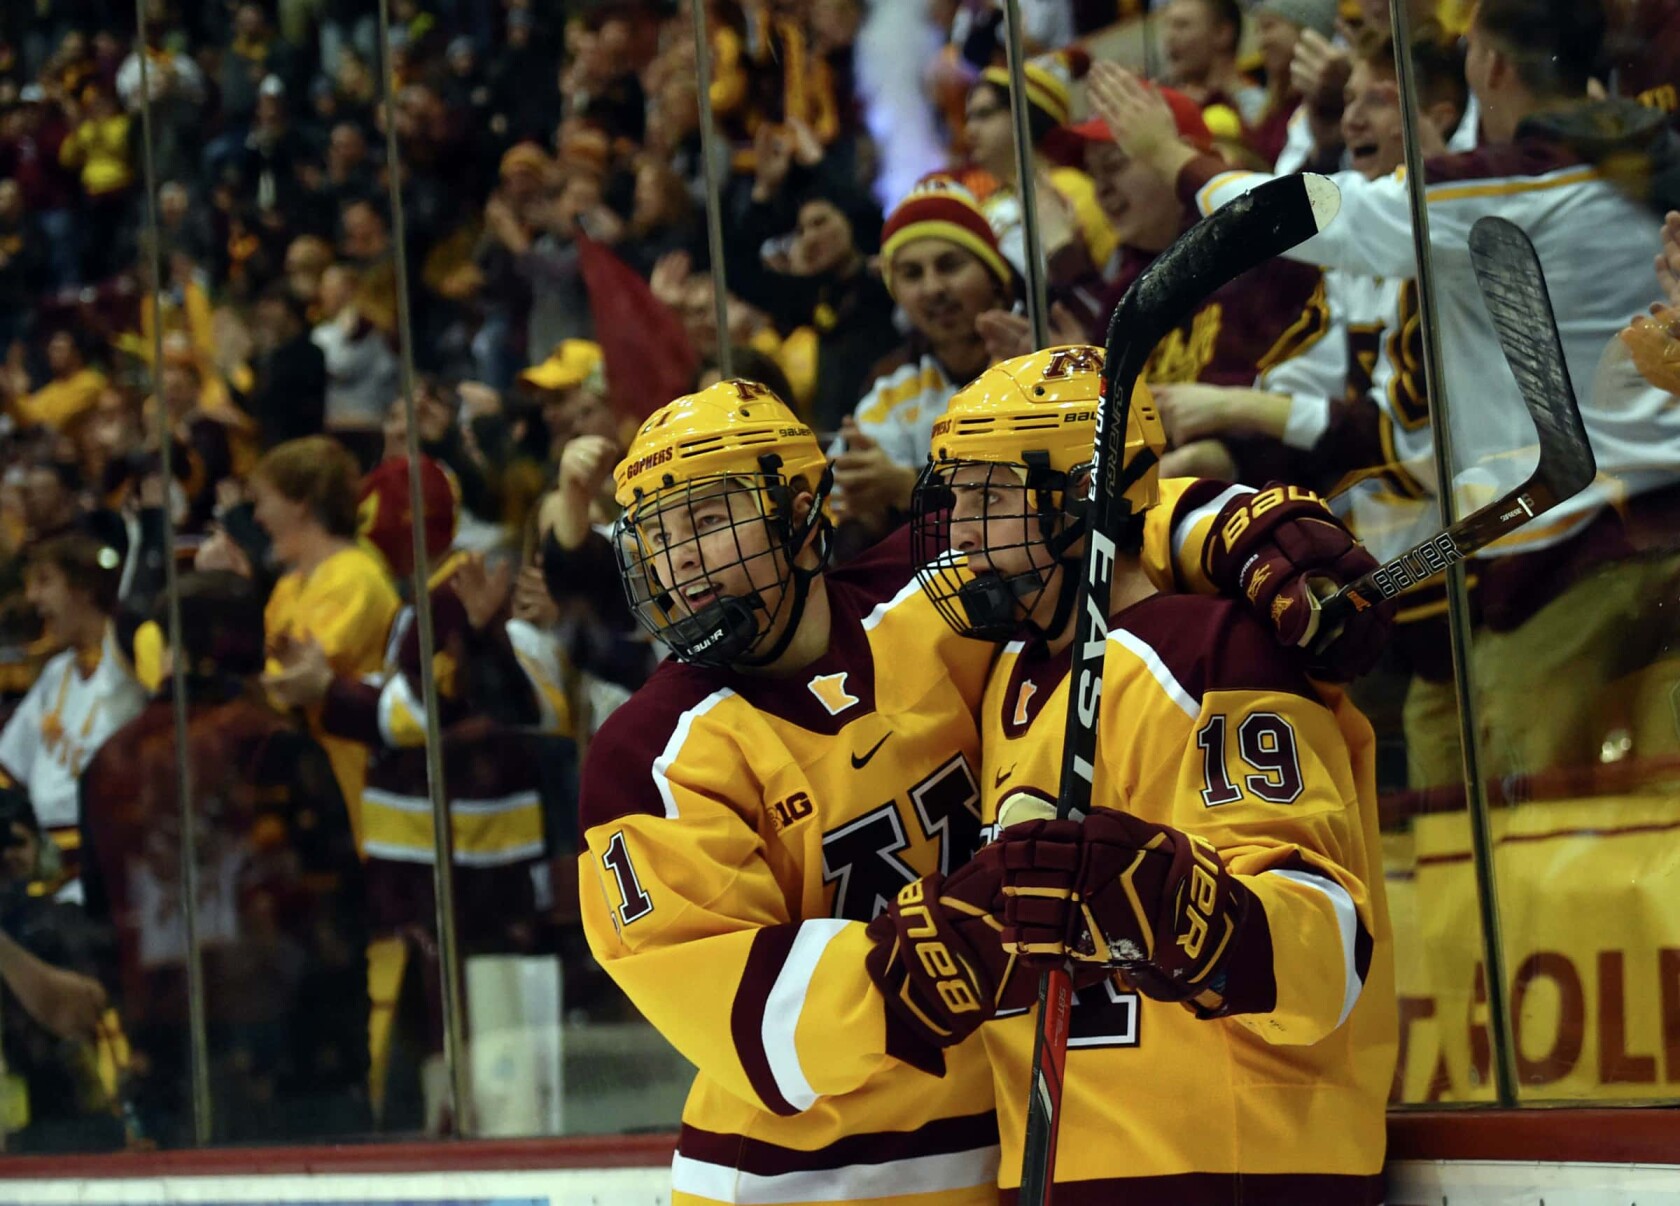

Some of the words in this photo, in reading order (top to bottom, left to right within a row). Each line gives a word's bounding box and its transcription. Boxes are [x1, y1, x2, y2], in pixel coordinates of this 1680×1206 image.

[626, 446, 674, 480] GOPHERS
[1087, 396, 1106, 502] EASTON
[1371, 532, 1467, 600] BAUER
[1197, 711, 1305, 808] 19
